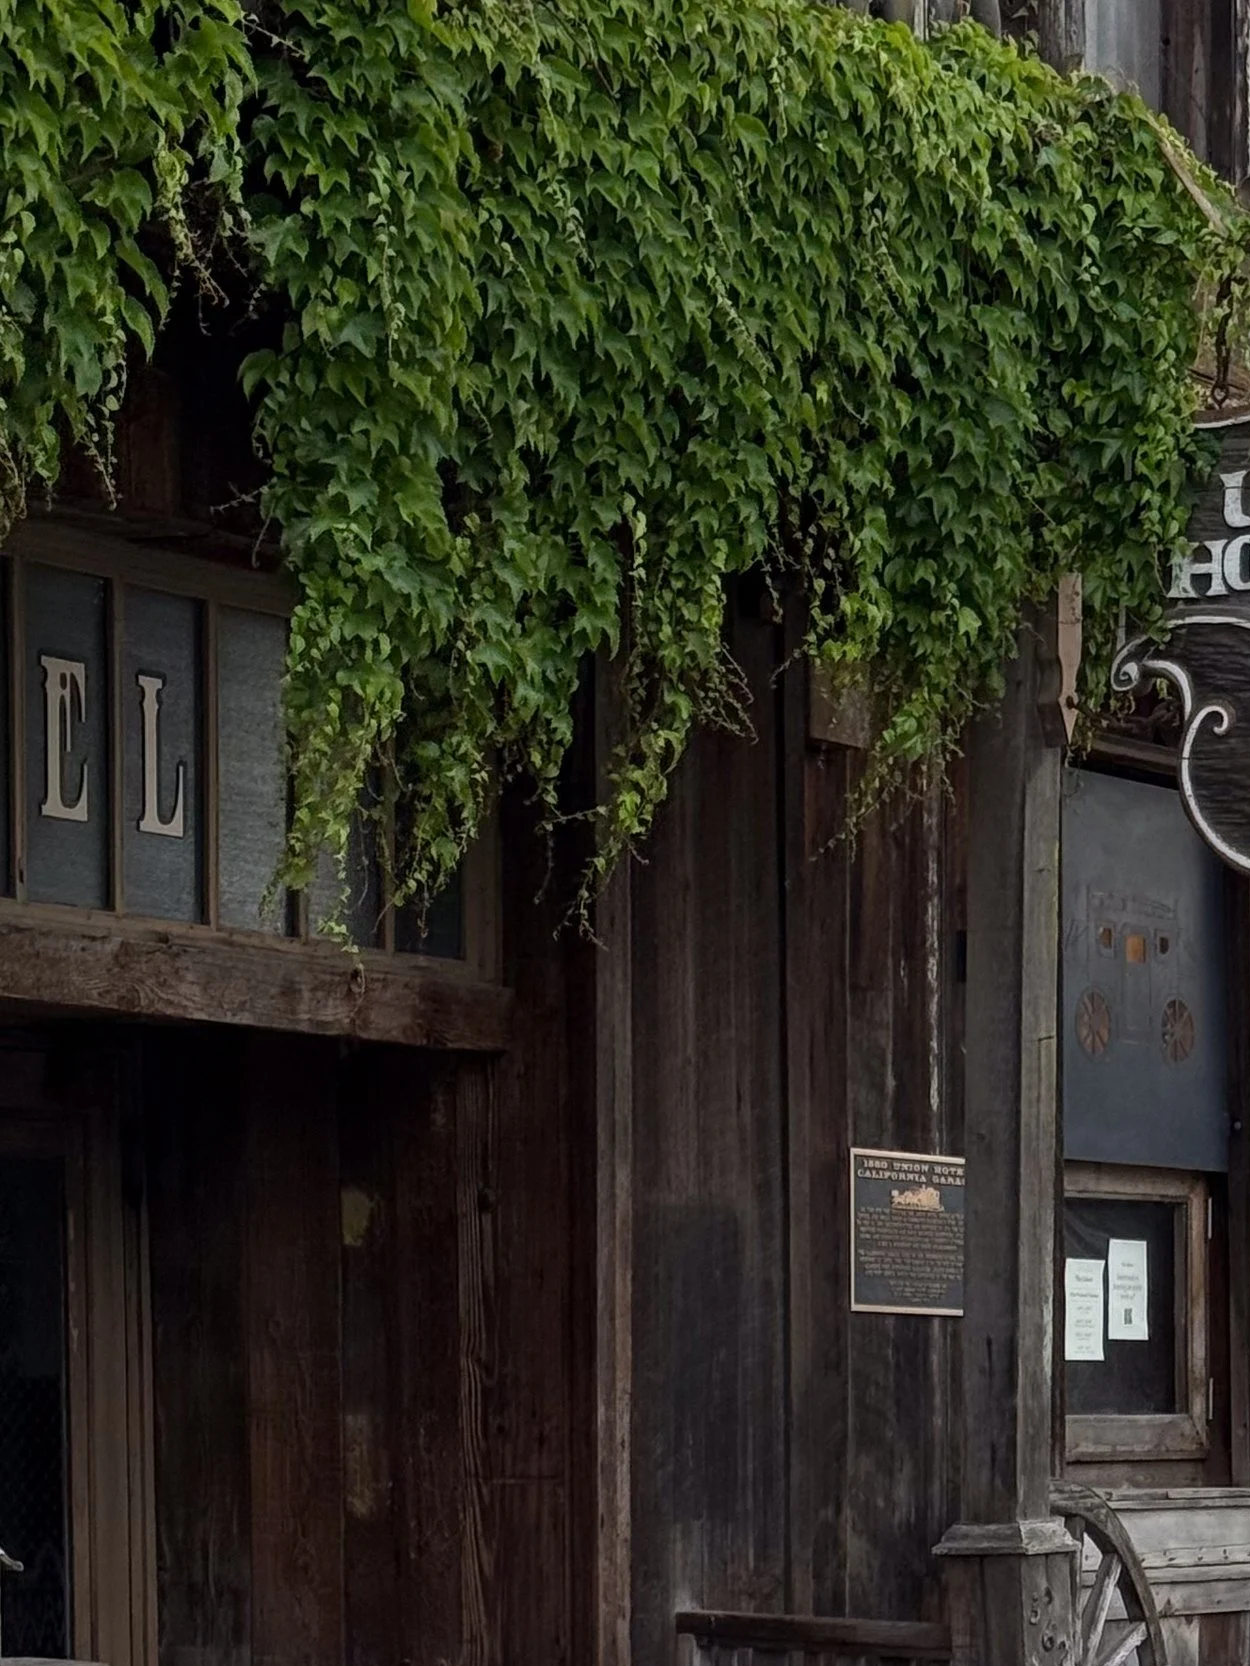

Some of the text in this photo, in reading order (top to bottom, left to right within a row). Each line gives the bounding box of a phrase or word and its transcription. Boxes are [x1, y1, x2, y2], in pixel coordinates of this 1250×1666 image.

[863, 1159, 889, 1170] 1880
[893, 1162, 928, 1173] UNION
[857, 1168, 926, 1183] CALIFORNIA
